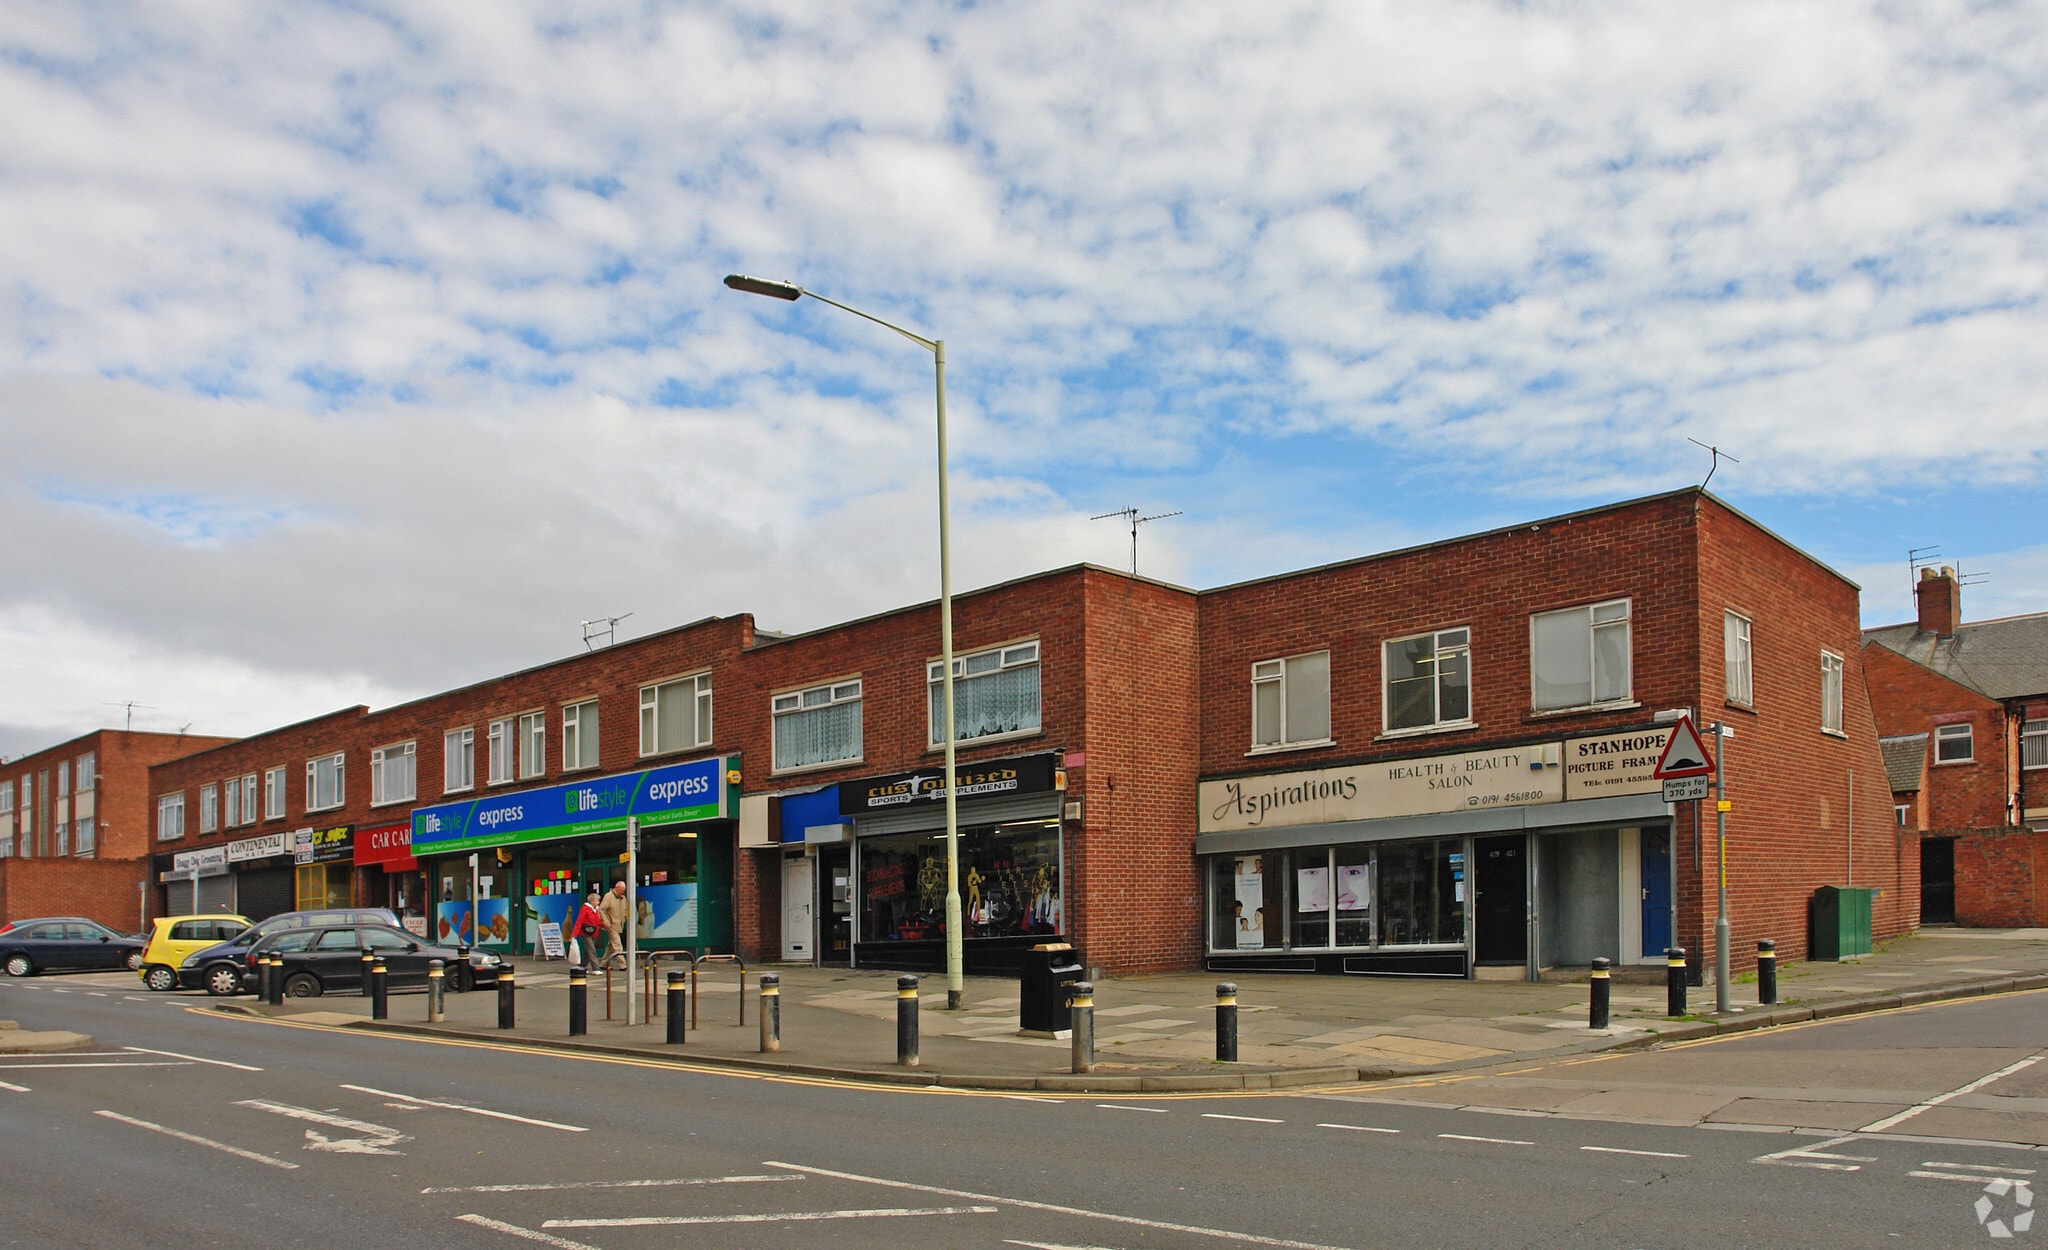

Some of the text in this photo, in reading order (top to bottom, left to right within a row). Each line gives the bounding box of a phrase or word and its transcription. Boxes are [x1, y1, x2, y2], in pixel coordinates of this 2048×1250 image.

[1579, 734, 1666, 756] STANHOPE
[1389, 755, 1522, 780] HEALTH & BEAUTY
[1568, 761, 1614, 774] PICTURE
[1428, 774, 1473, 790] SALON
[1665, 780, 1692, 790] Humps
[579, 776, 708, 812] lifestyle express
[870, 794, 908, 805] SPORTS
[1212, 776, 1357, 826] Aspirations
[1482, 790, 1543, 804] 0191 4561800
[1669, 788, 1702, 798] 370 yds
[426, 806, 524, 834] lifestyle express
[230, 836, 281, 854] CONTINENTAL
[372, 833, 389, 849] CAR
[201, 853, 222, 864] Grooming
[245, 850, 265, 858] HAIR
